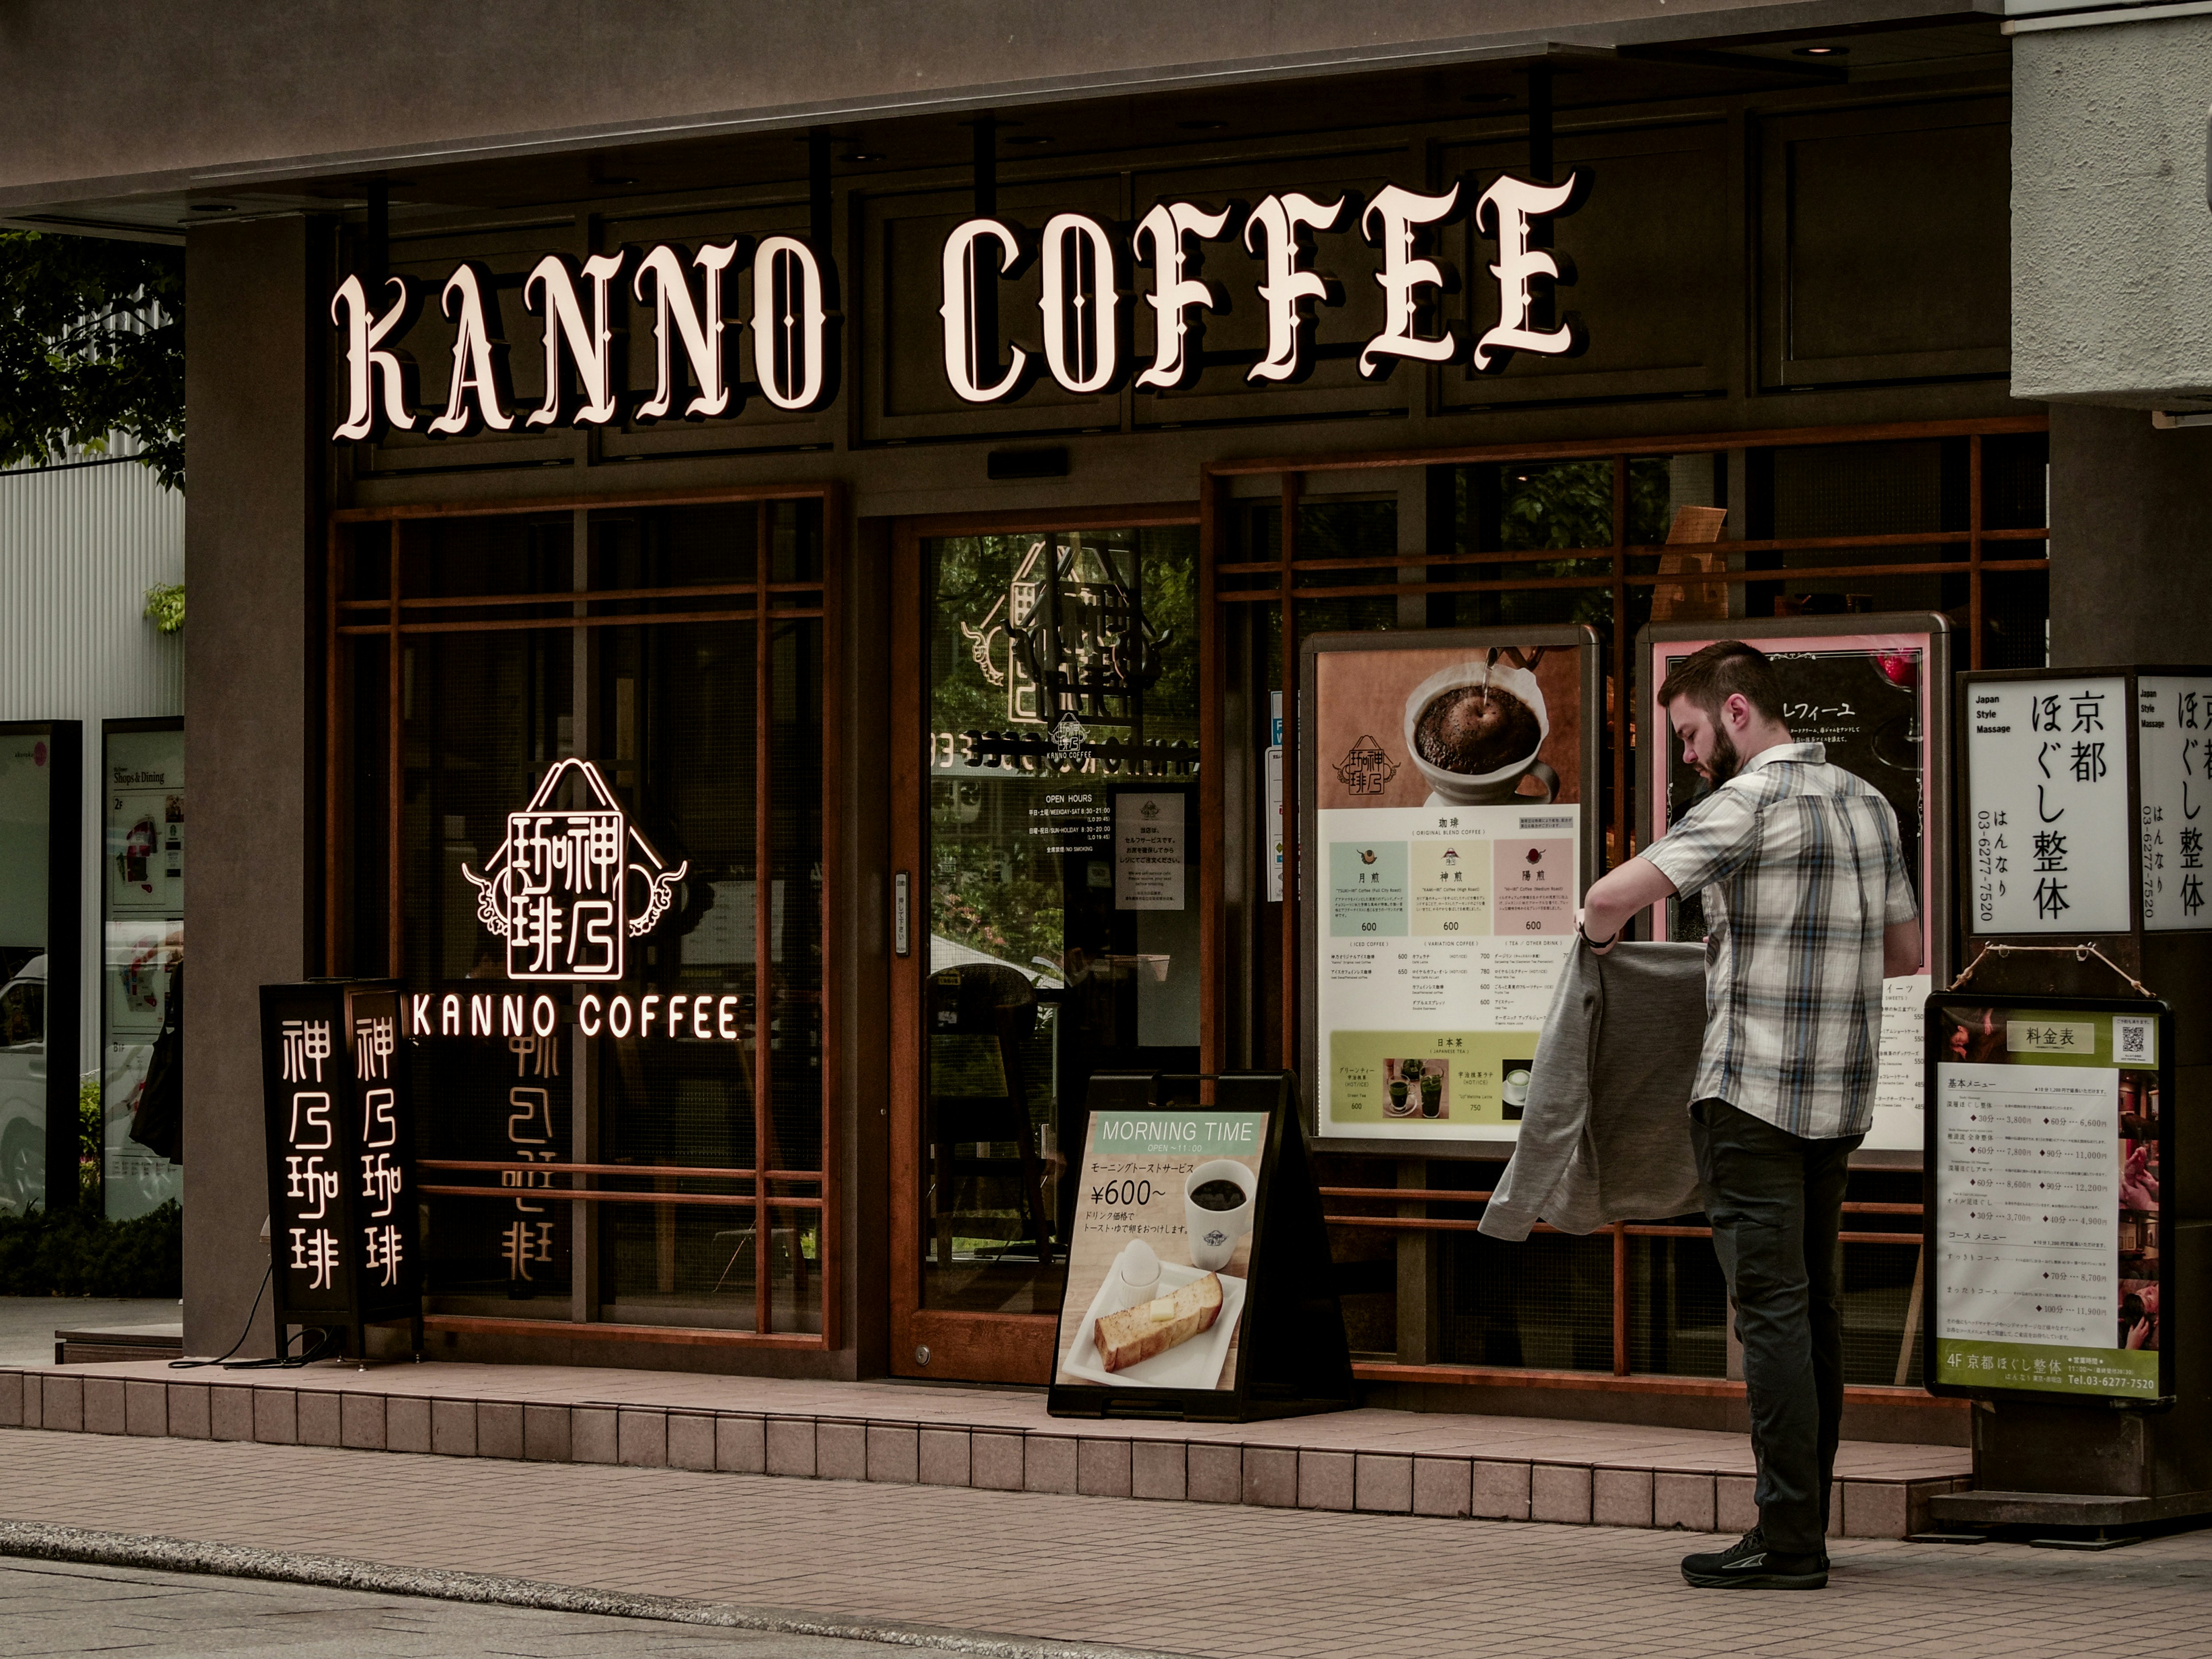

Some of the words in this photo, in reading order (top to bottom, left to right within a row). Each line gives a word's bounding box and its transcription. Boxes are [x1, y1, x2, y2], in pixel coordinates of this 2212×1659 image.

[332, 235, 826, 442] KANNO
[940, 171, 1578, 403] COFFEE
[2140, 689, 2157, 699] Japan
[1976, 695, 2000, 704] Japan
[2140, 704, 2155, 713] Style
[1976, 710, 1997, 719] Style
[2141, 719, 2165, 729] Massage
[1977, 725, 2011, 734] Massage
[2069, 690, 2107, 783] 京都
[114, 772, 134, 786] Shops
[134, 772, 141, 783] &
[141, 772, 165, 785] Dining
[1068, 794, 1092, 803] HOURS
[115, 798, 123, 810] 2F
[2032, 694, 2070, 920] ほぐし整体
[2178, 691, 2205, 917] ほぐし整体
[1438, 818, 1459, 828] 珈琲
[1993, 810, 2008, 897] はんなり
[2153, 806, 2164, 893] はんなり
[1977, 810, 1993, 922] 03-6277-7520
[2142, 806, 2154, 918] 03-6277-7520
[1359, 872, 1379, 883] 月煎
[1440, 871, 1463, 882] 神煎
[1522, 870, 1545, 881] 陽煎
[1361, 922, 1377, 931] 600
[1443, 922, 1459, 930] 600
[1526, 921, 1541, 929] 600
[1887, 984, 1913, 994] イーツ
[413, 994, 555, 1037] KANNO
[579, 995, 738, 1038] COFFEE
[2026, 1027, 2075, 1045] 料金表
[1437, 1037, 1463, 1047] 日本茶
[1948, 1078, 1997, 1088] 基本メニュー
[1978, 1114, 1994, 1123] 30分
[2006, 1116, 2032, 1124] 3,800円
[2051, 1118, 2066, 1126] 60分
[2080, 1119, 2107, 1127] 6,600円
[1102, 1121, 1197, 1141] MORNING
[1205, 1122, 1253, 1141] TIME
[1977, 1146, 1994, 1155] 60分
[2076, 1151, 2107, 1160] 11,000円
[1091, 1163, 1194, 1173] モーニングトーストサービス
[1977, 1179, 1993, 1187] 60分
[2007, 1180, 2032, 1189] 8,600円
[2046, 1182, 2062, 1190] 90分
[2075, 1184, 2108, 1192] 12,200円
[1086, 1211, 1135, 1221] ドリンク価格で
[1977, 1212, 1993, 1220] 30分
[2007, 1214, 2032, 1222] 3,700円
[2050, 1215, 2066, 1224] 40分
[2081, 1217, 2107, 1225] 4,900円
[1084, 1223, 1188, 1235] トースト・ゆで卵をおつけします。
[2051, 1272, 2067, 1281] 70分
[2081, 1274, 2107, 1282] 8,700円
[1947, 1286, 1998, 1294] まったりコース
[2044, 1306, 2063, 1314] 100分
[2077, 1307, 2107, 1316] 11,900円
[1947, 1353, 1963, 1367] 4F
[1967, 1354, 2062, 1375] 京都ほぐし整体
[2068, 1375, 2154, 1389] Tel.03-6277-7520
